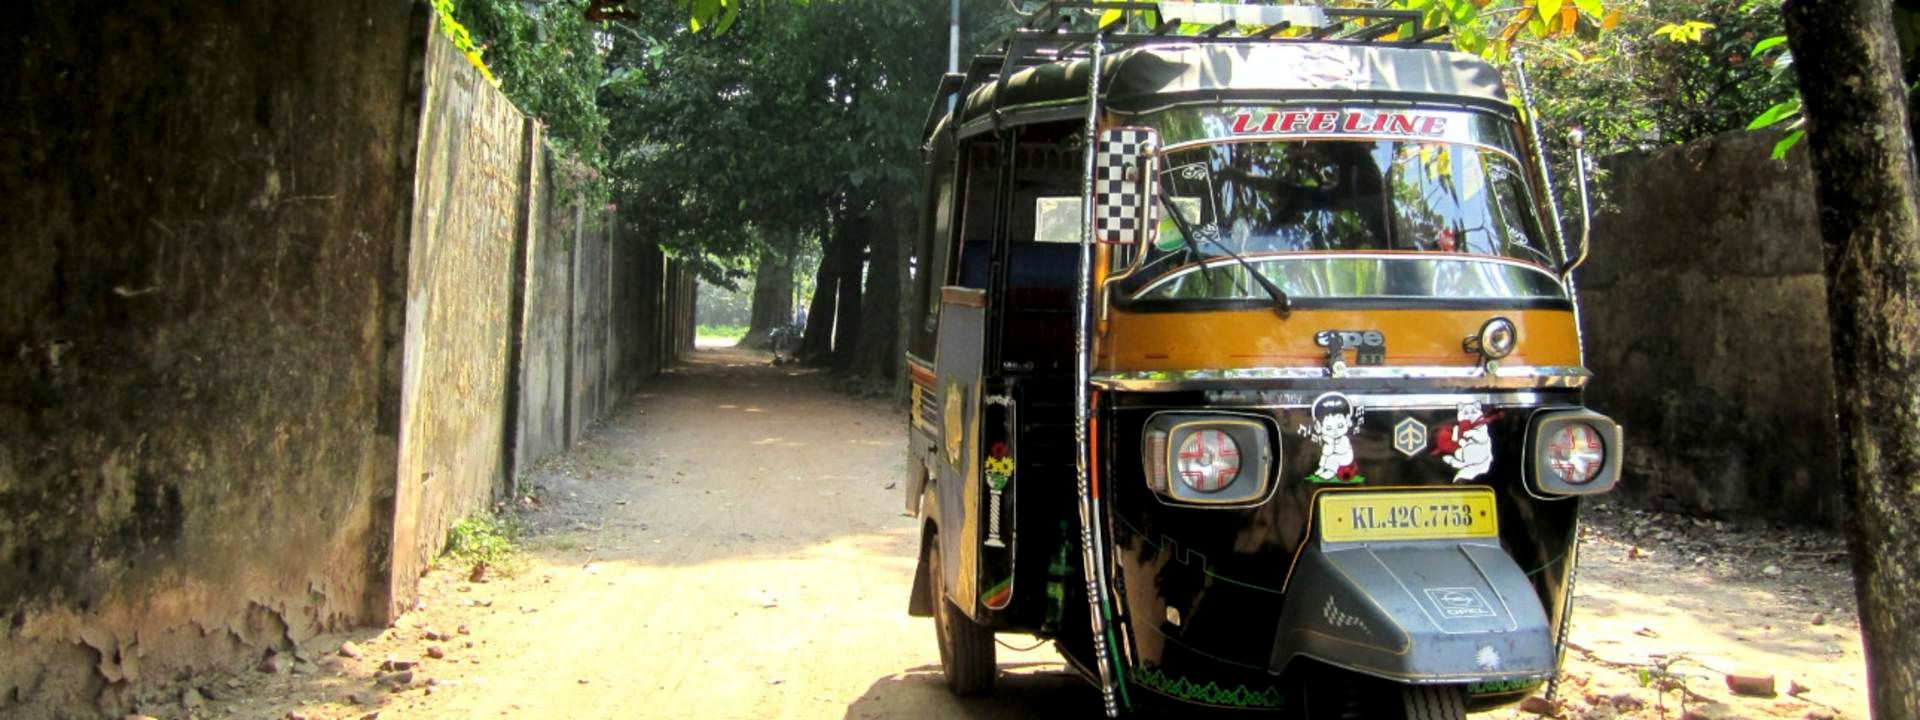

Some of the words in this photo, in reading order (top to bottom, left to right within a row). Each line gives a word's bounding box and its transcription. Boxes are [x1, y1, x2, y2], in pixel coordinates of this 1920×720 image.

[1231, 111, 1339, 134] LIFE
[1343, 111, 1448, 135] LINE
[1351, 504, 1473, 529] KL.42C.7753
[1446, 608, 1489, 616] OPEL
